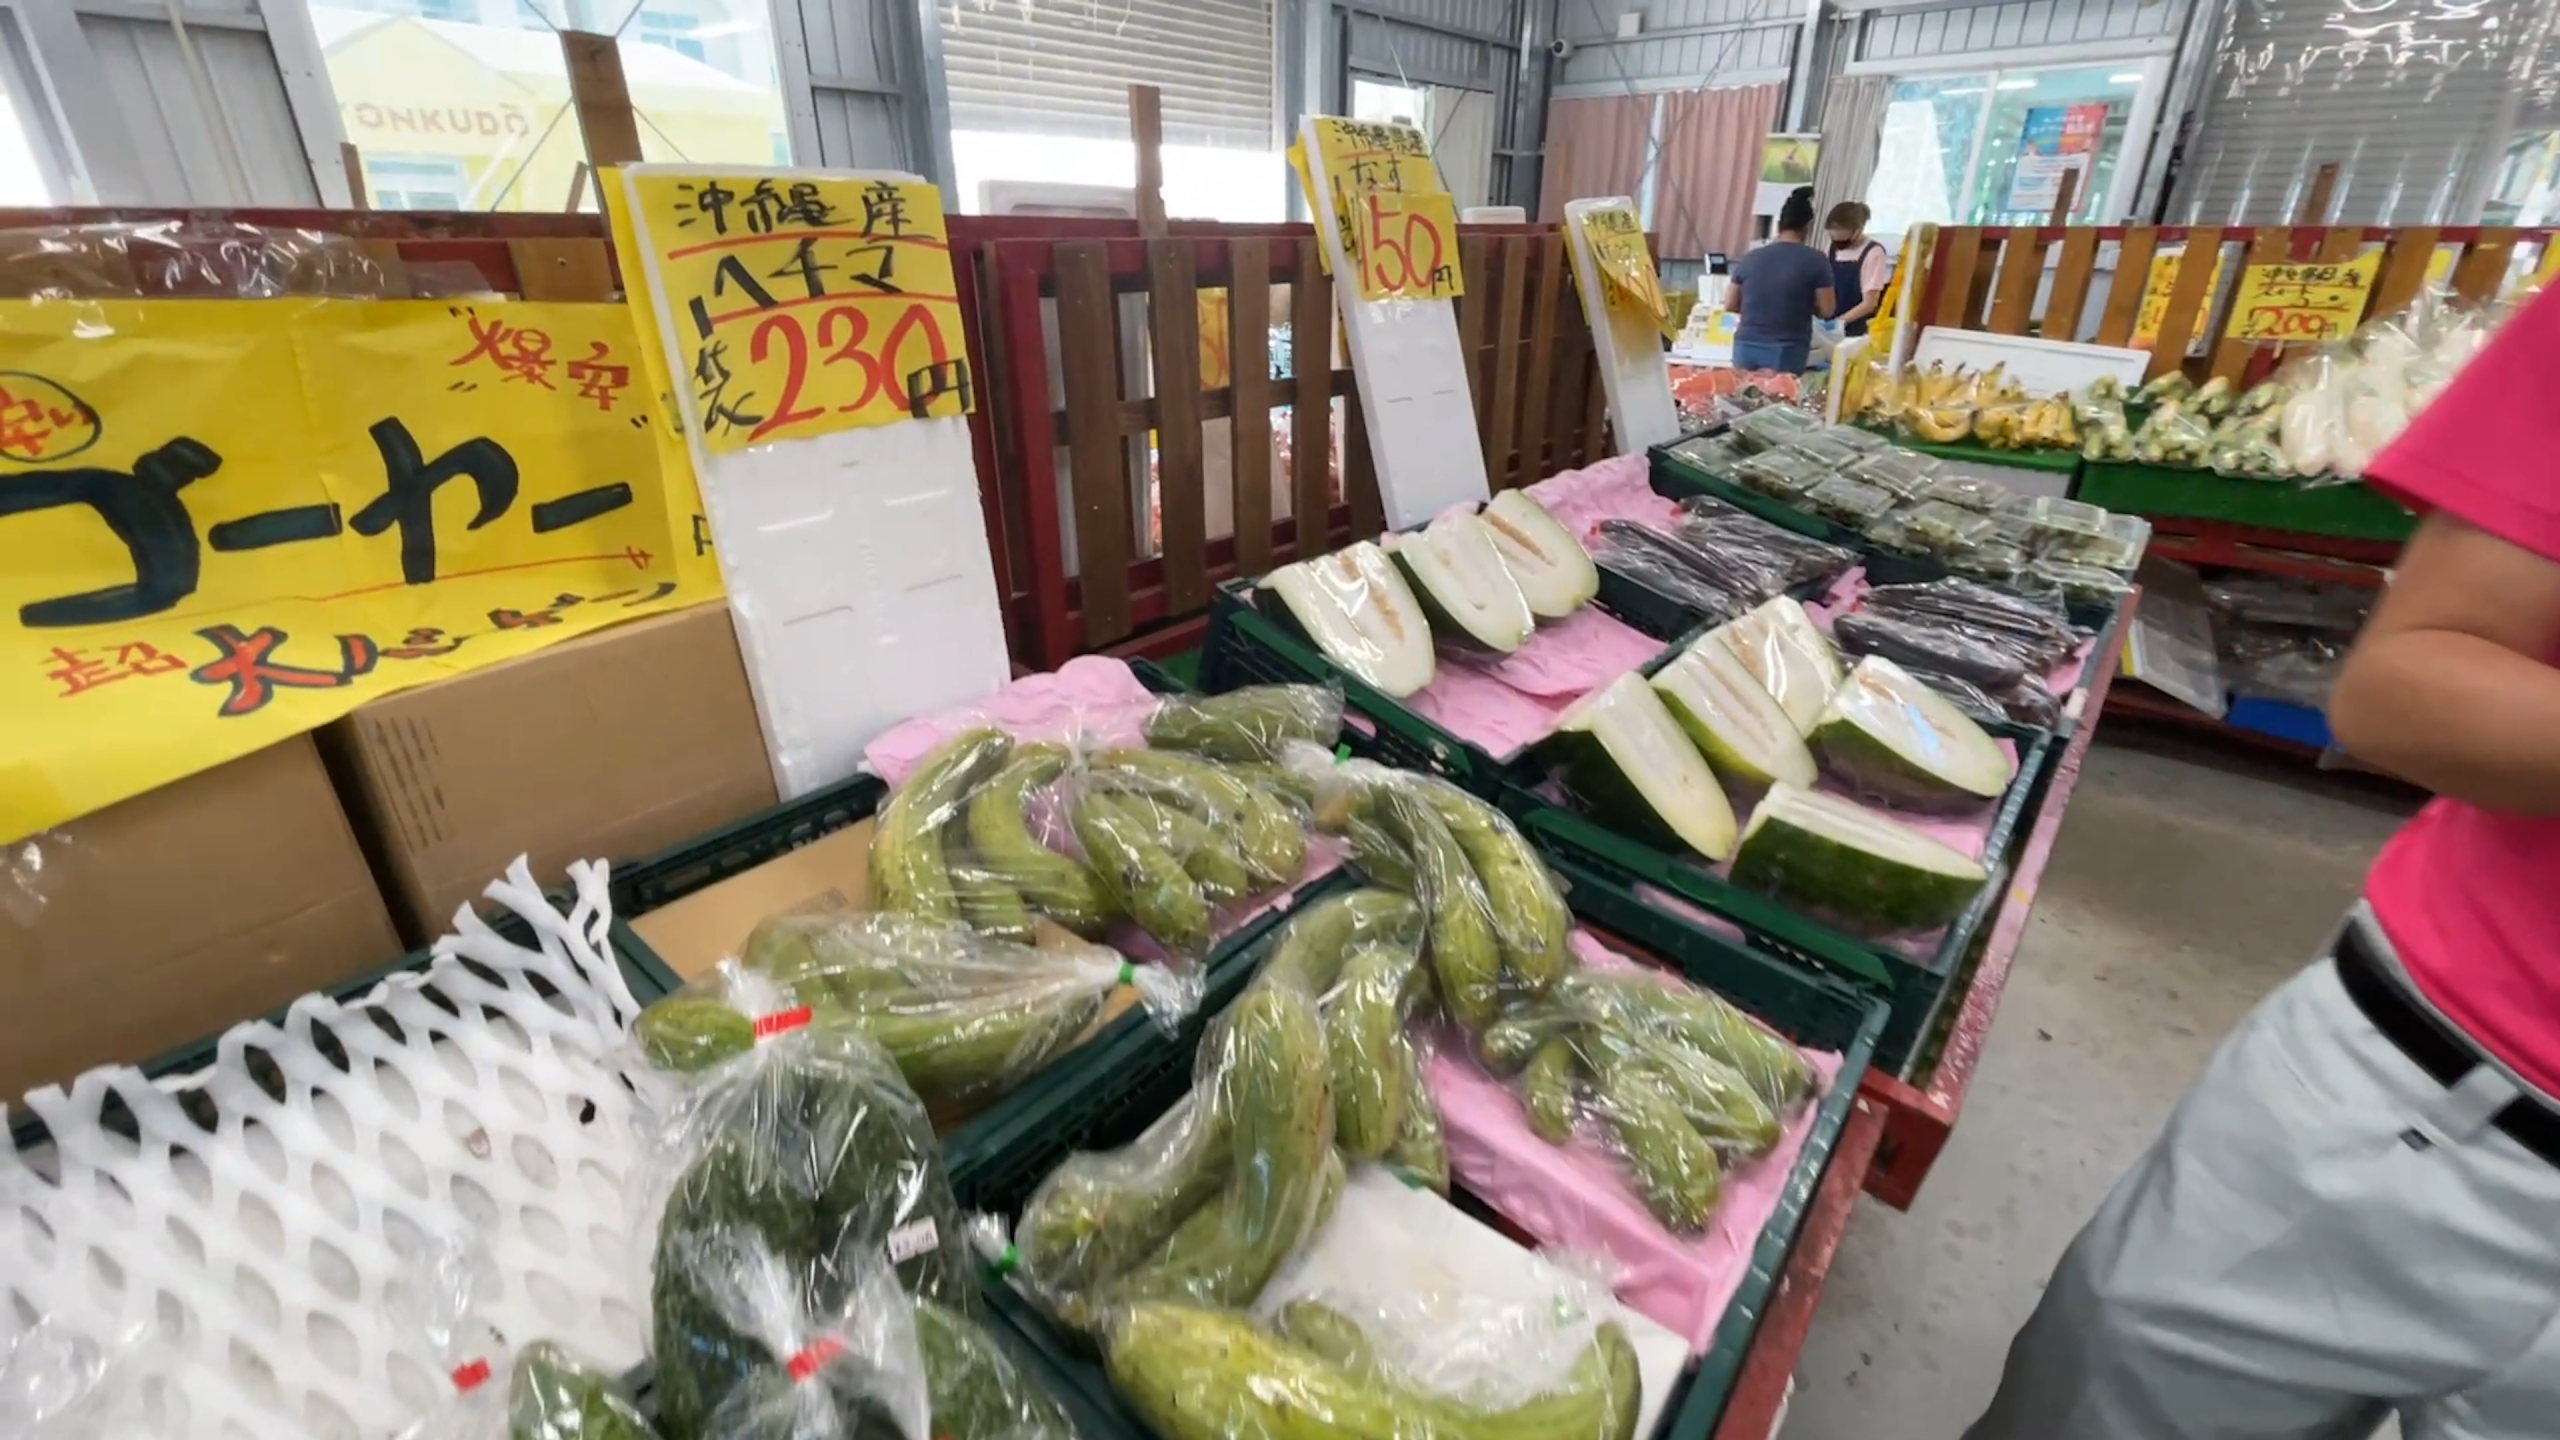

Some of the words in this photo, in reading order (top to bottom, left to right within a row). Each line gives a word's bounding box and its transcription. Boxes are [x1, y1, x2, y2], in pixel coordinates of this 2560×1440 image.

[673, 178, 938, 241] 沖縄産
[1349, 153, 1402, 193] なす
[713, 236, 905, 309] ヘチマ
[1359, 194, 1454, 296] 150円
[747, 302, 972, 442] 230円
[0, 416, 633, 627] ゴーヤー
